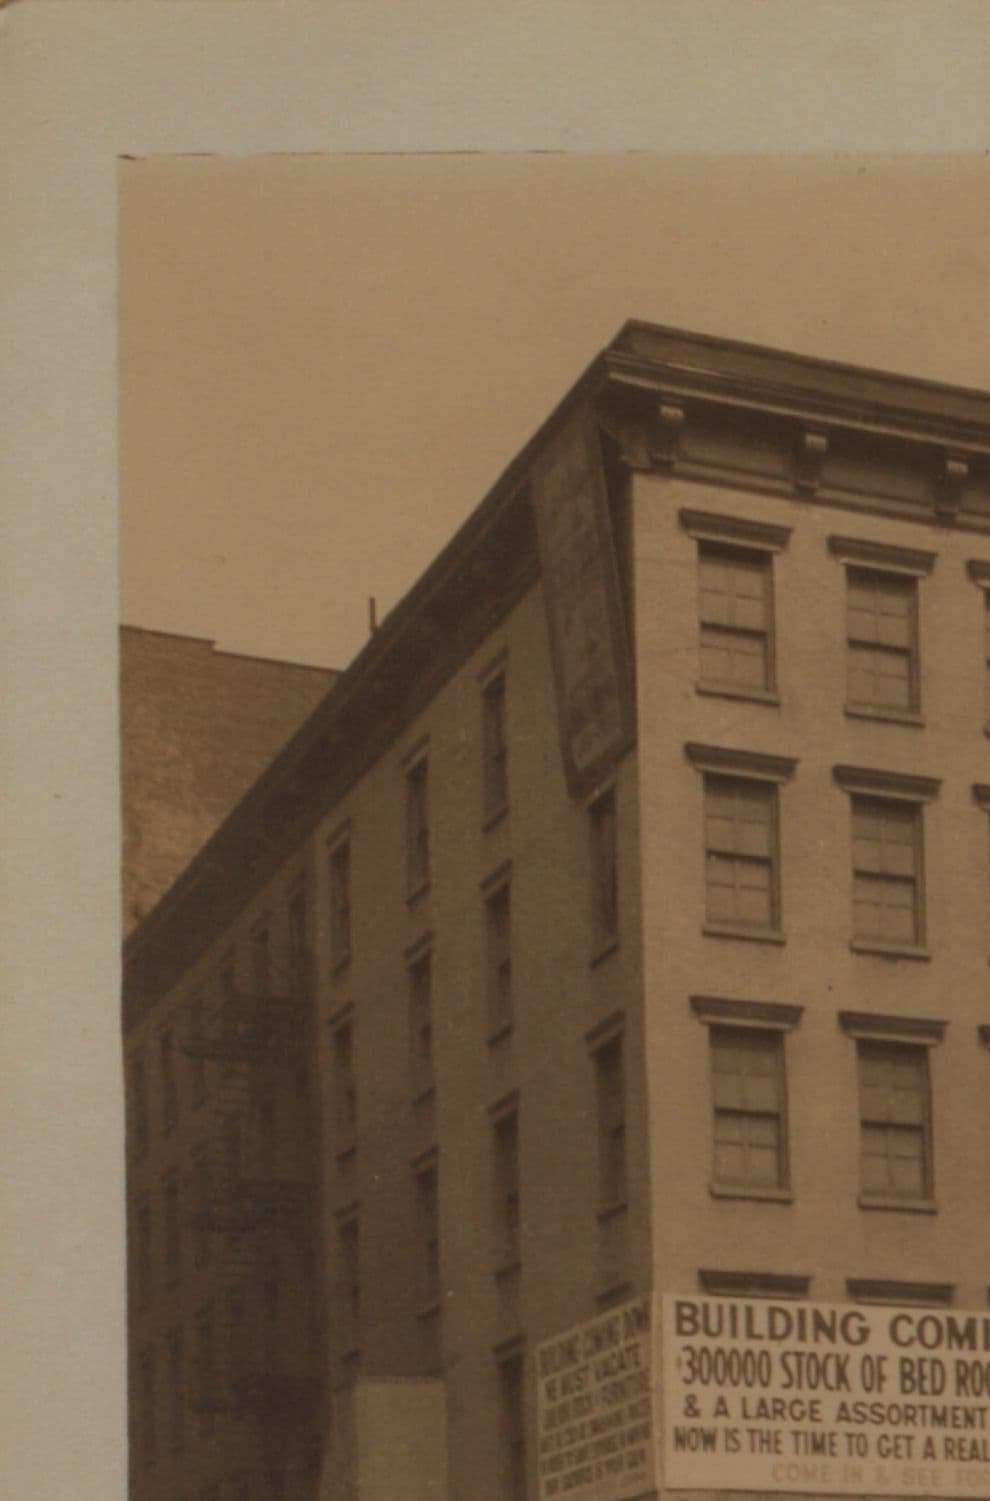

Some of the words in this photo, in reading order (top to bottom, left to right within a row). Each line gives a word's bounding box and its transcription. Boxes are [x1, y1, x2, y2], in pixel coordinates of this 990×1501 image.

[675, 1301, 871, 1347] BUILDING
[780, 1350, 850, 1393] STOCK
[861, 1354, 888, 1394] OF
[899, 1356, 946, 1397] BED
[684, 1394, 700, 1418] &
[713, 1395, 730, 1418] A
[741, 1396, 823, 1423] LARGE
[835, 1401, 988, 1429] ASSORTMENT
[674, 1426, 718, 1453] NOW
[724, 1428, 741, 1453] IS
[746, 1427, 783, 1455] THE
[791, 1429, 837, 1457] TIME
[844, 1431, 869, 1459] TO
[876, 1433, 915, 1460] GET
[922, 1436, 937, 1460] A
[772, 1463, 834, 1484] COME
